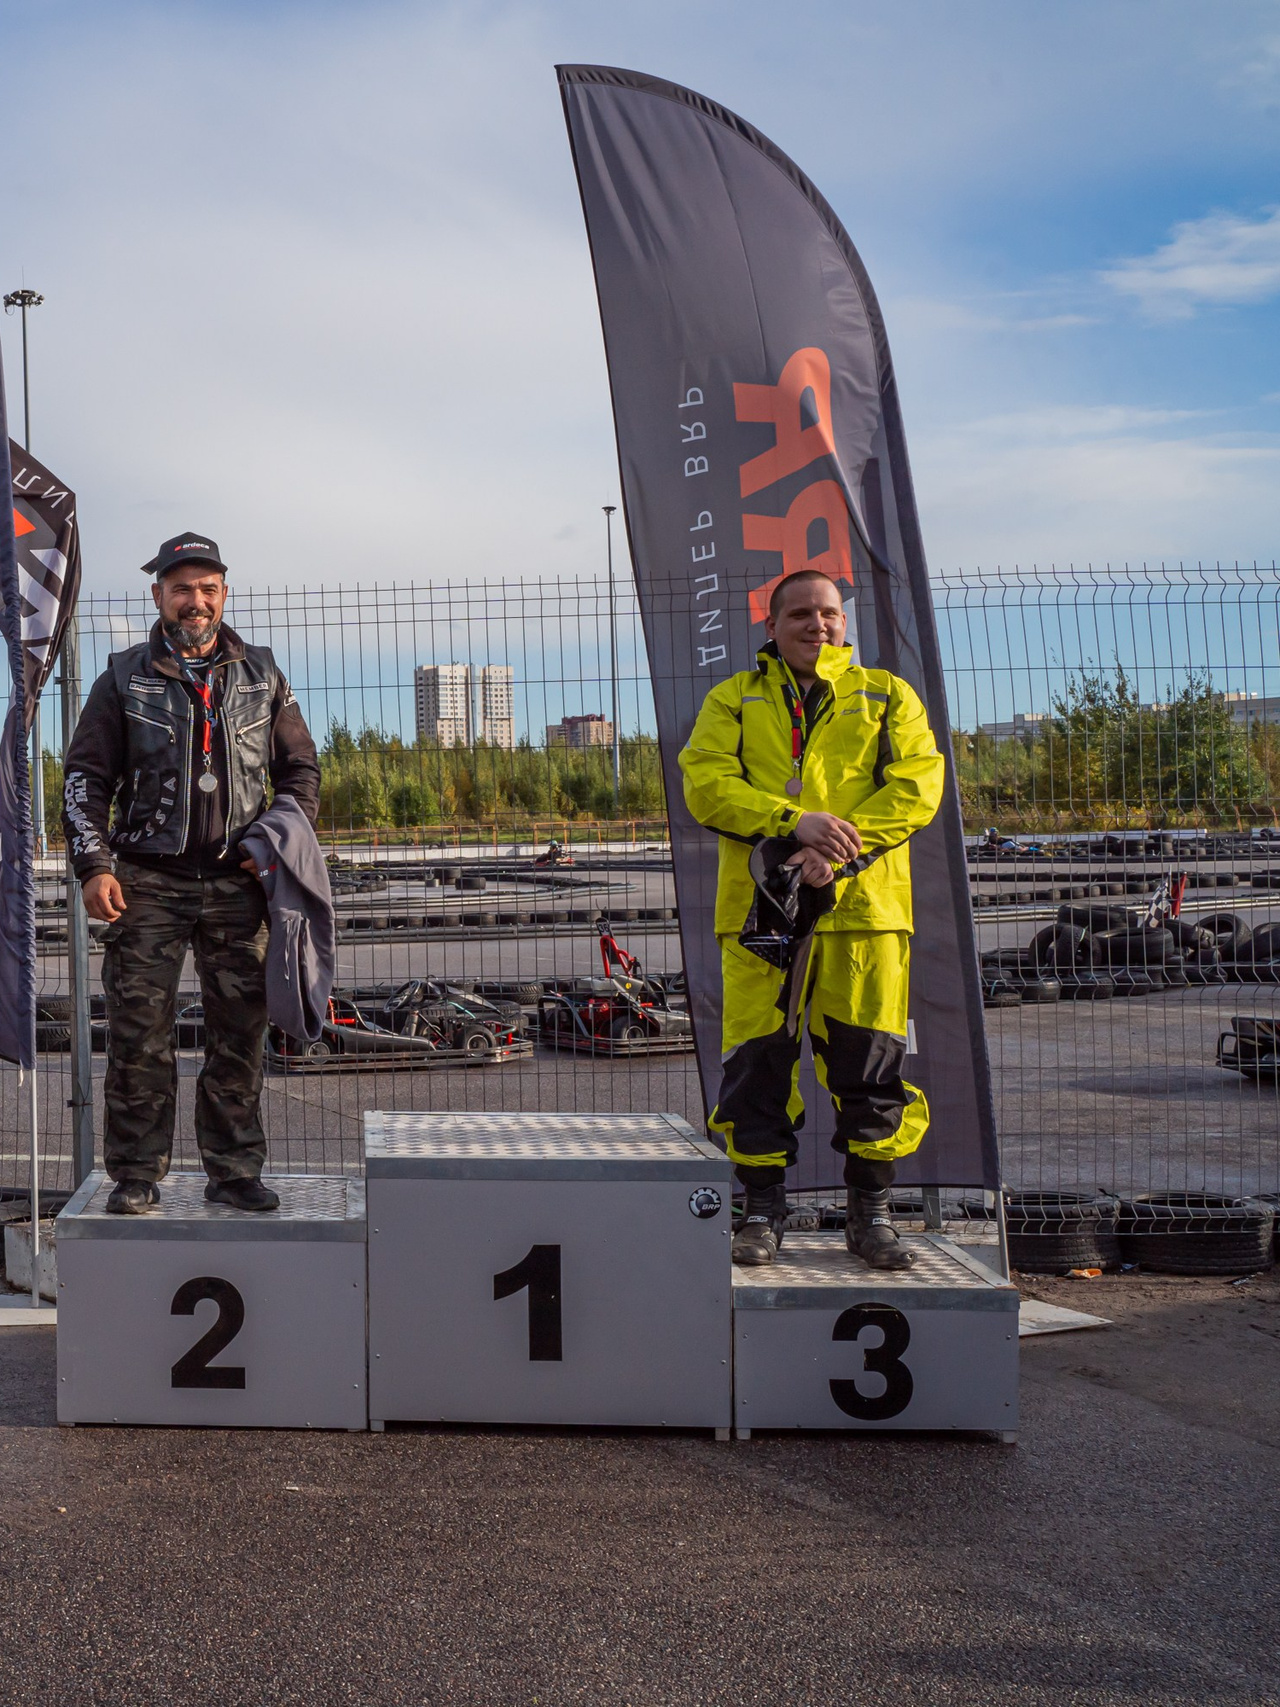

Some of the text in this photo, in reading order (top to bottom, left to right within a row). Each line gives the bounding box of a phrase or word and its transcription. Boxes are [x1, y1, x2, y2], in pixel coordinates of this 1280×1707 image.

[116, 776, 177, 843] RUSSIA
[170, 1275, 246, 1390] 2
[493, 1245, 563, 1362] 1
[828, 1302, 913, 1420] 3
